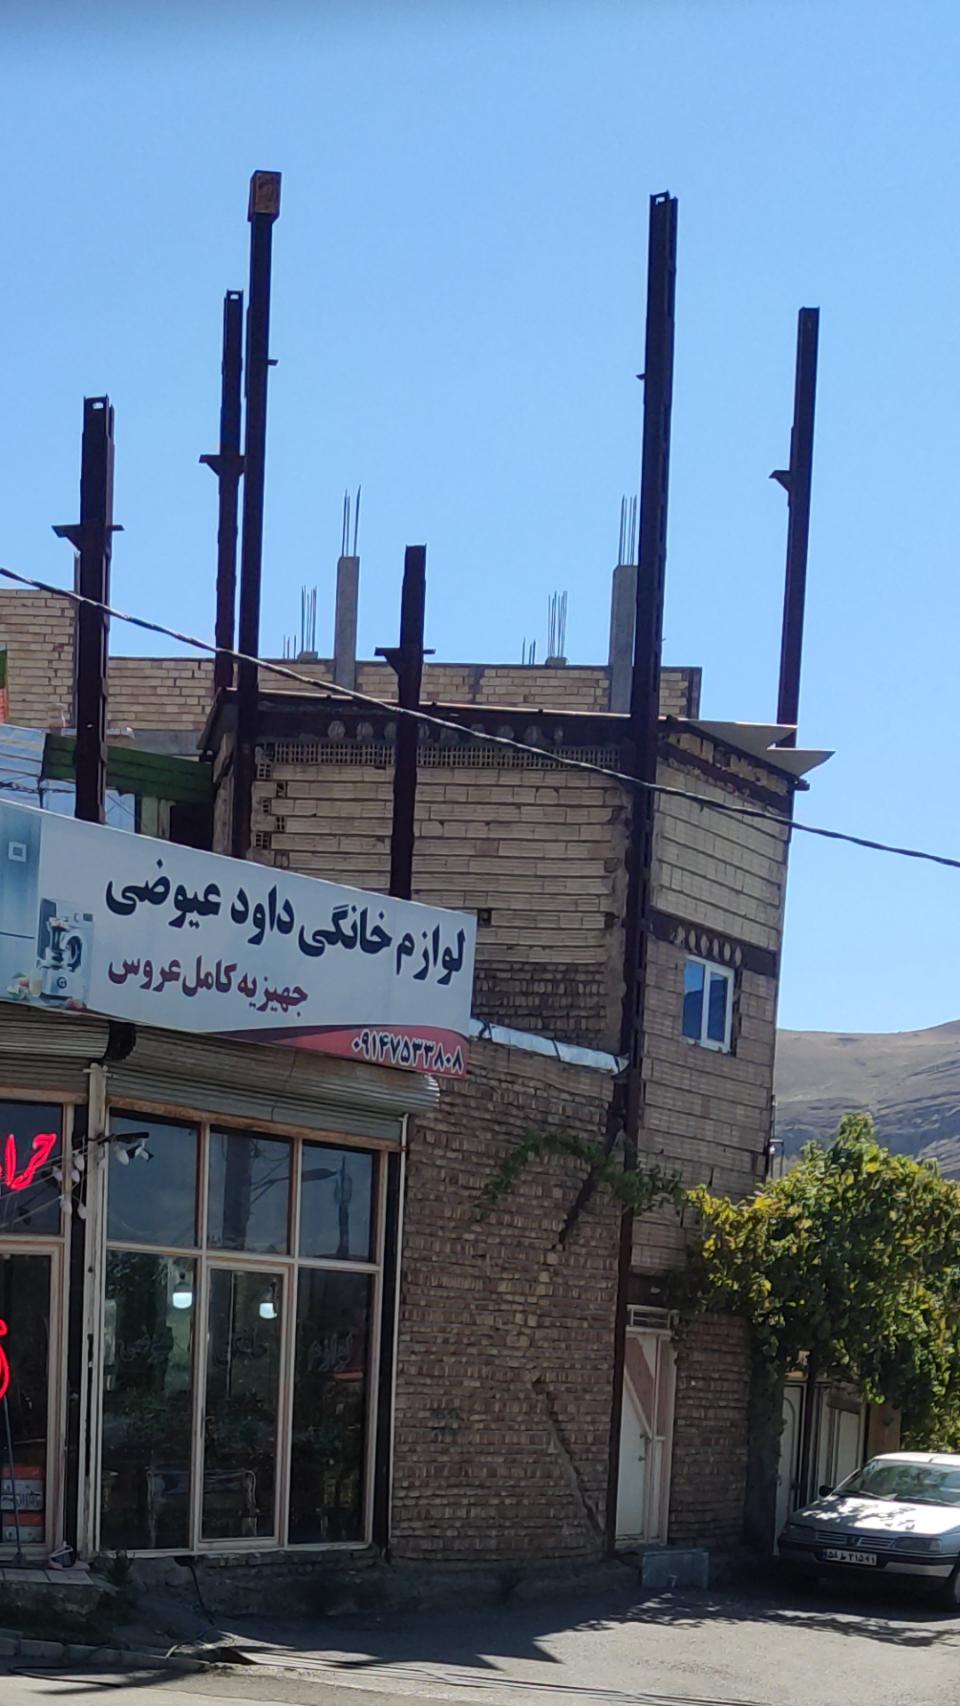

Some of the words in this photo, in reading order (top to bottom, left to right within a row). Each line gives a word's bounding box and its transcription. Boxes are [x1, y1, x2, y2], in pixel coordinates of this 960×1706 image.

[106, 859, 221, 928] عیوضی
[231, 885, 294, 945] داود
[298, 904, 392, 957] خانگی
[396, 923, 466, 985] لوازم
[108, 957, 181, 992] عروس
[182, 955, 237, 997] کامل
[237, 972, 308, 1017] جهیزیه
[352, 1029, 464, 1074] ۰۹۱۴۷۵۳۳۸۰۸
